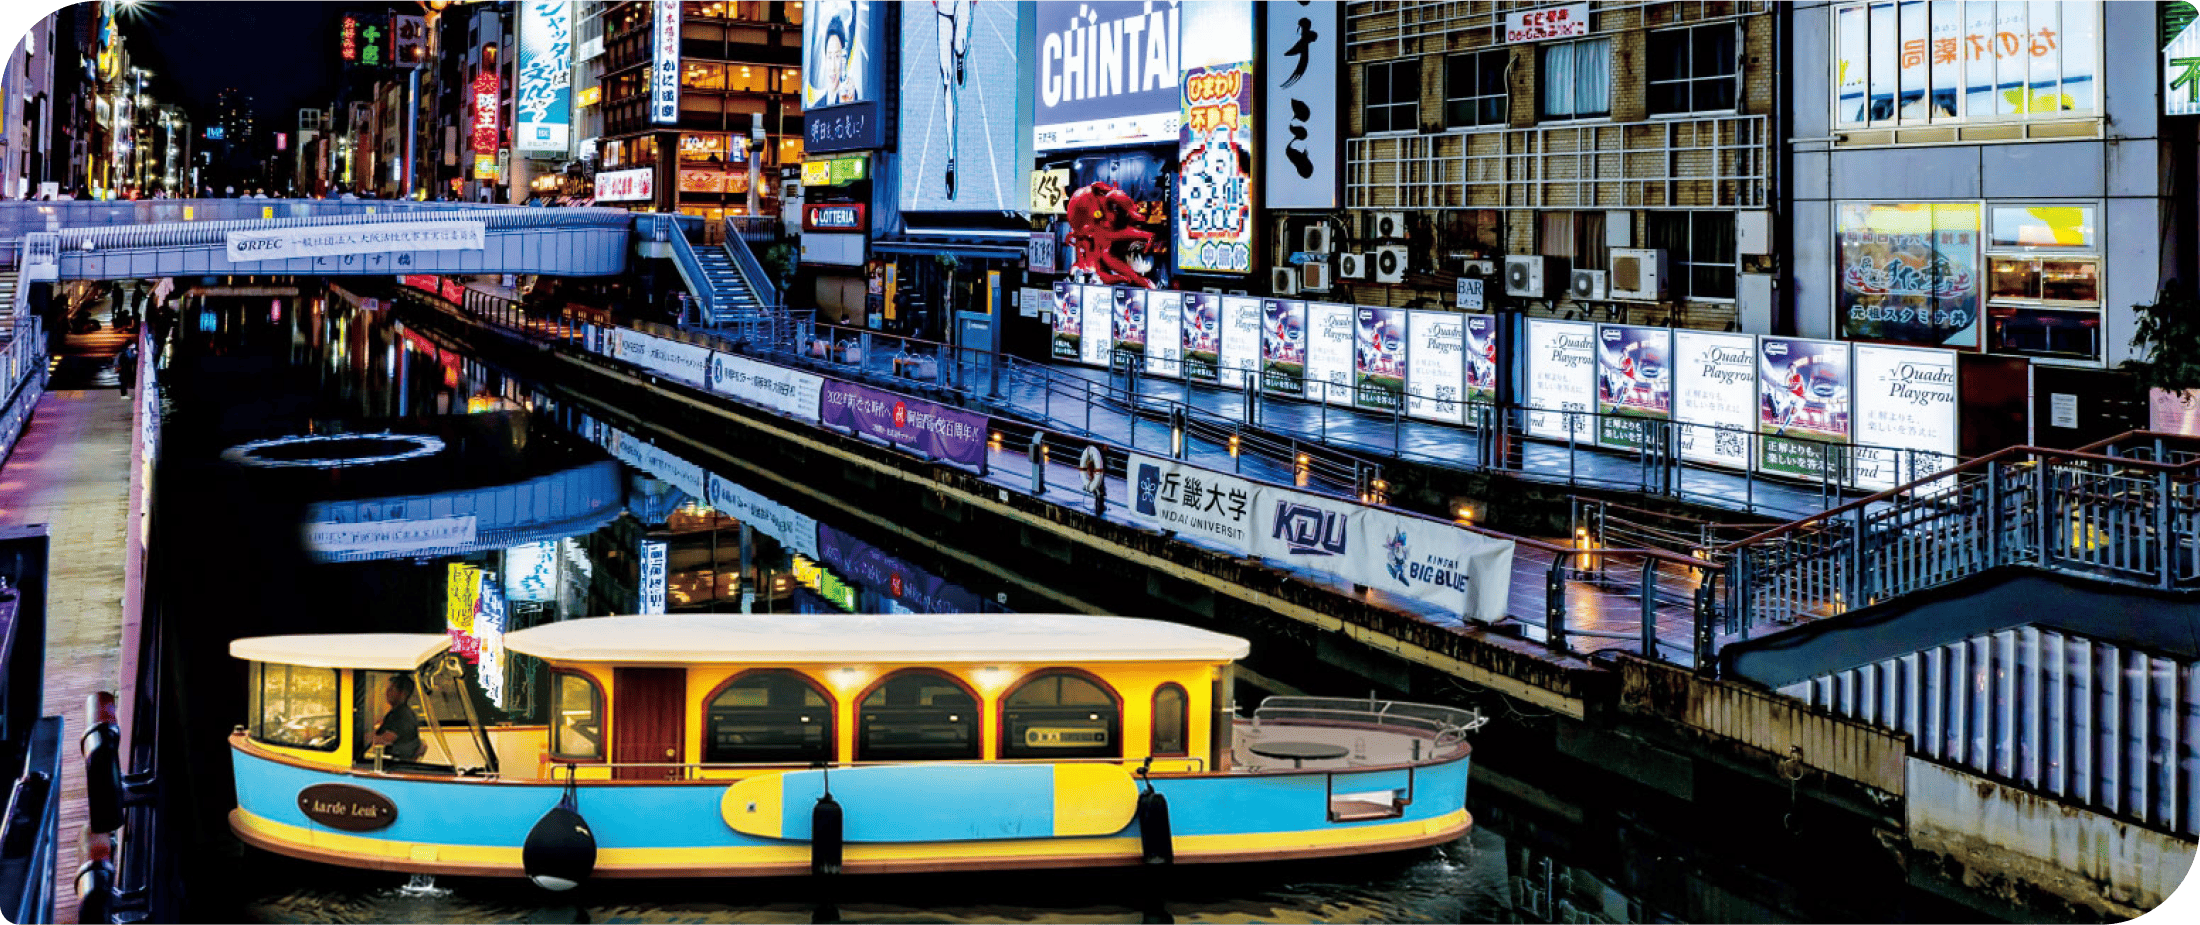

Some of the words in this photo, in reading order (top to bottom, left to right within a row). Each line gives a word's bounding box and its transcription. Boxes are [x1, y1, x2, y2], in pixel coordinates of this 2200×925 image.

[1042, 2, 1180, 107] CHINTAI
[1188, 70, 1241, 101] ひまわり
[1280, 0, 1318, 179] ナミ
[818, 210, 855, 224] LOTTERIA
[1458, 281, 1482, 295] BAR
[1850, 305, 1967, 327] 元祖スタミナ丼
[1768, 440, 1821, 459] 正解よりも、
[1158, 471, 1248, 521] 近畿大学
[1160, 509, 1189, 524] NDAI
[1272, 499, 1348, 555] KDU
[1409, 561, 1434, 583] BIG
[1434, 568, 1470, 592] BLUE
